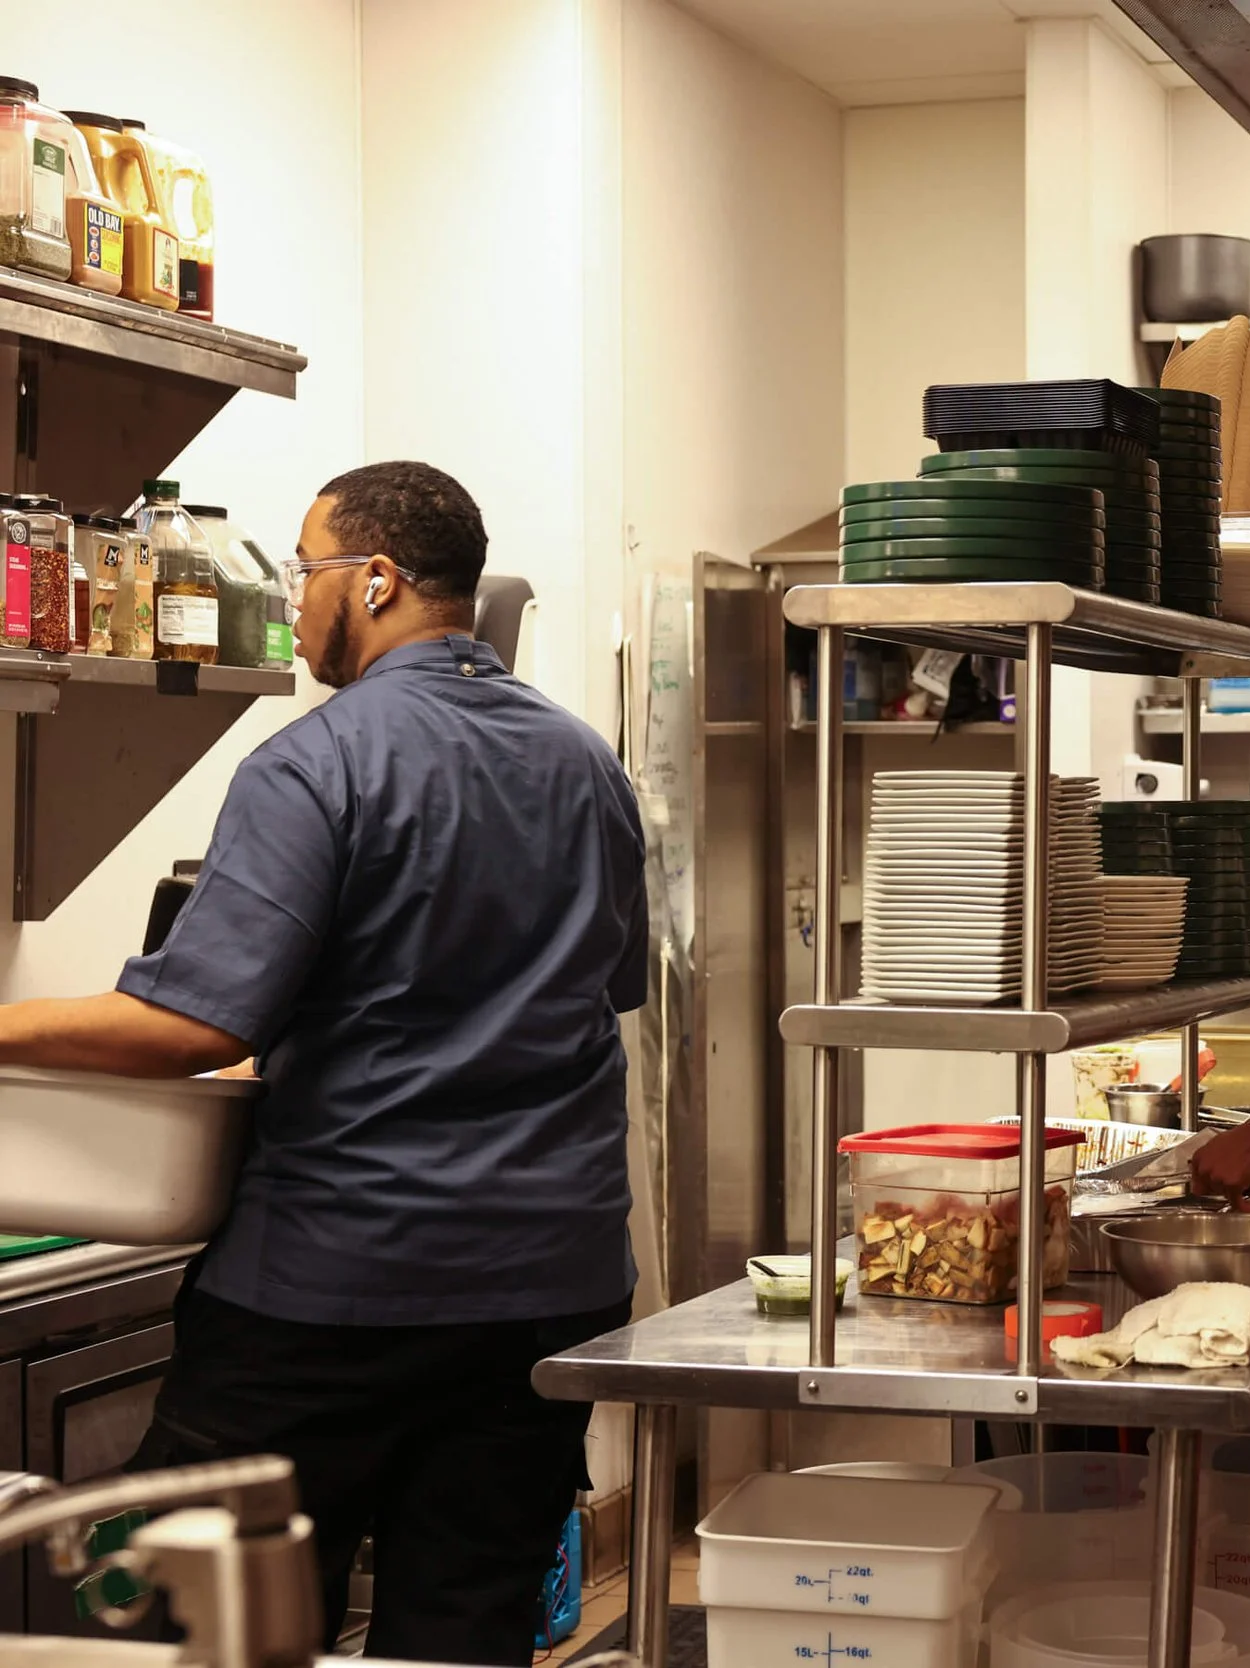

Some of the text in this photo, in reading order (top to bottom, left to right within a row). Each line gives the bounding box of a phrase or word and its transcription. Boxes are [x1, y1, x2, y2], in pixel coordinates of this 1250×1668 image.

[88, 207, 104, 226] OLD
[1225, 1553, 1250, 1564] 22qt
[795, 1647, 813, 1658] 15L
